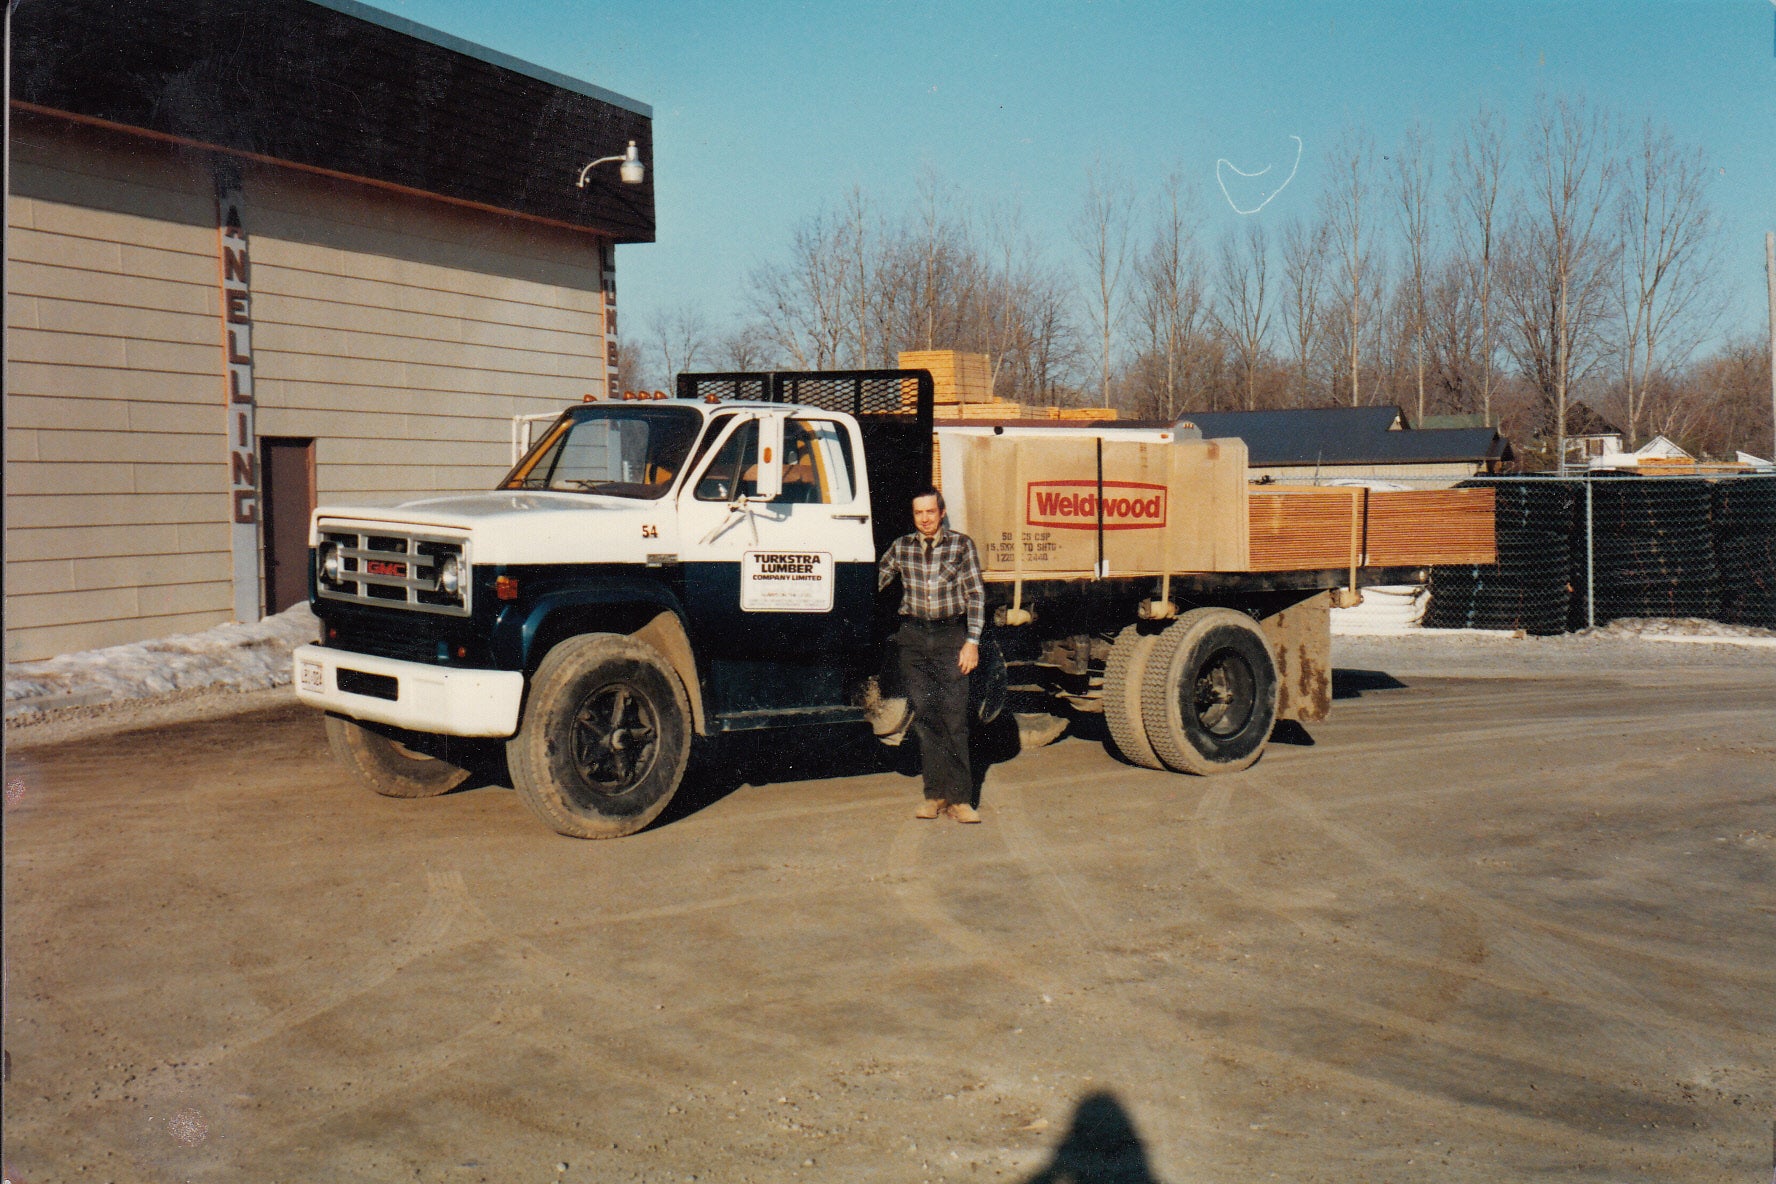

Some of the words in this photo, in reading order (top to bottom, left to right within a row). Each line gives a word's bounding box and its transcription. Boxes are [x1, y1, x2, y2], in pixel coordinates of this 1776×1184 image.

[602, 246, 621, 431] LUMBE
[1036, 492, 1160, 518] Weldwood
[642, 525, 658, 538] 54
[753, 554, 821, 564] TURKSTRA
[367, 561, 407, 577] GMC
[761, 564, 813, 573] LUMBER
